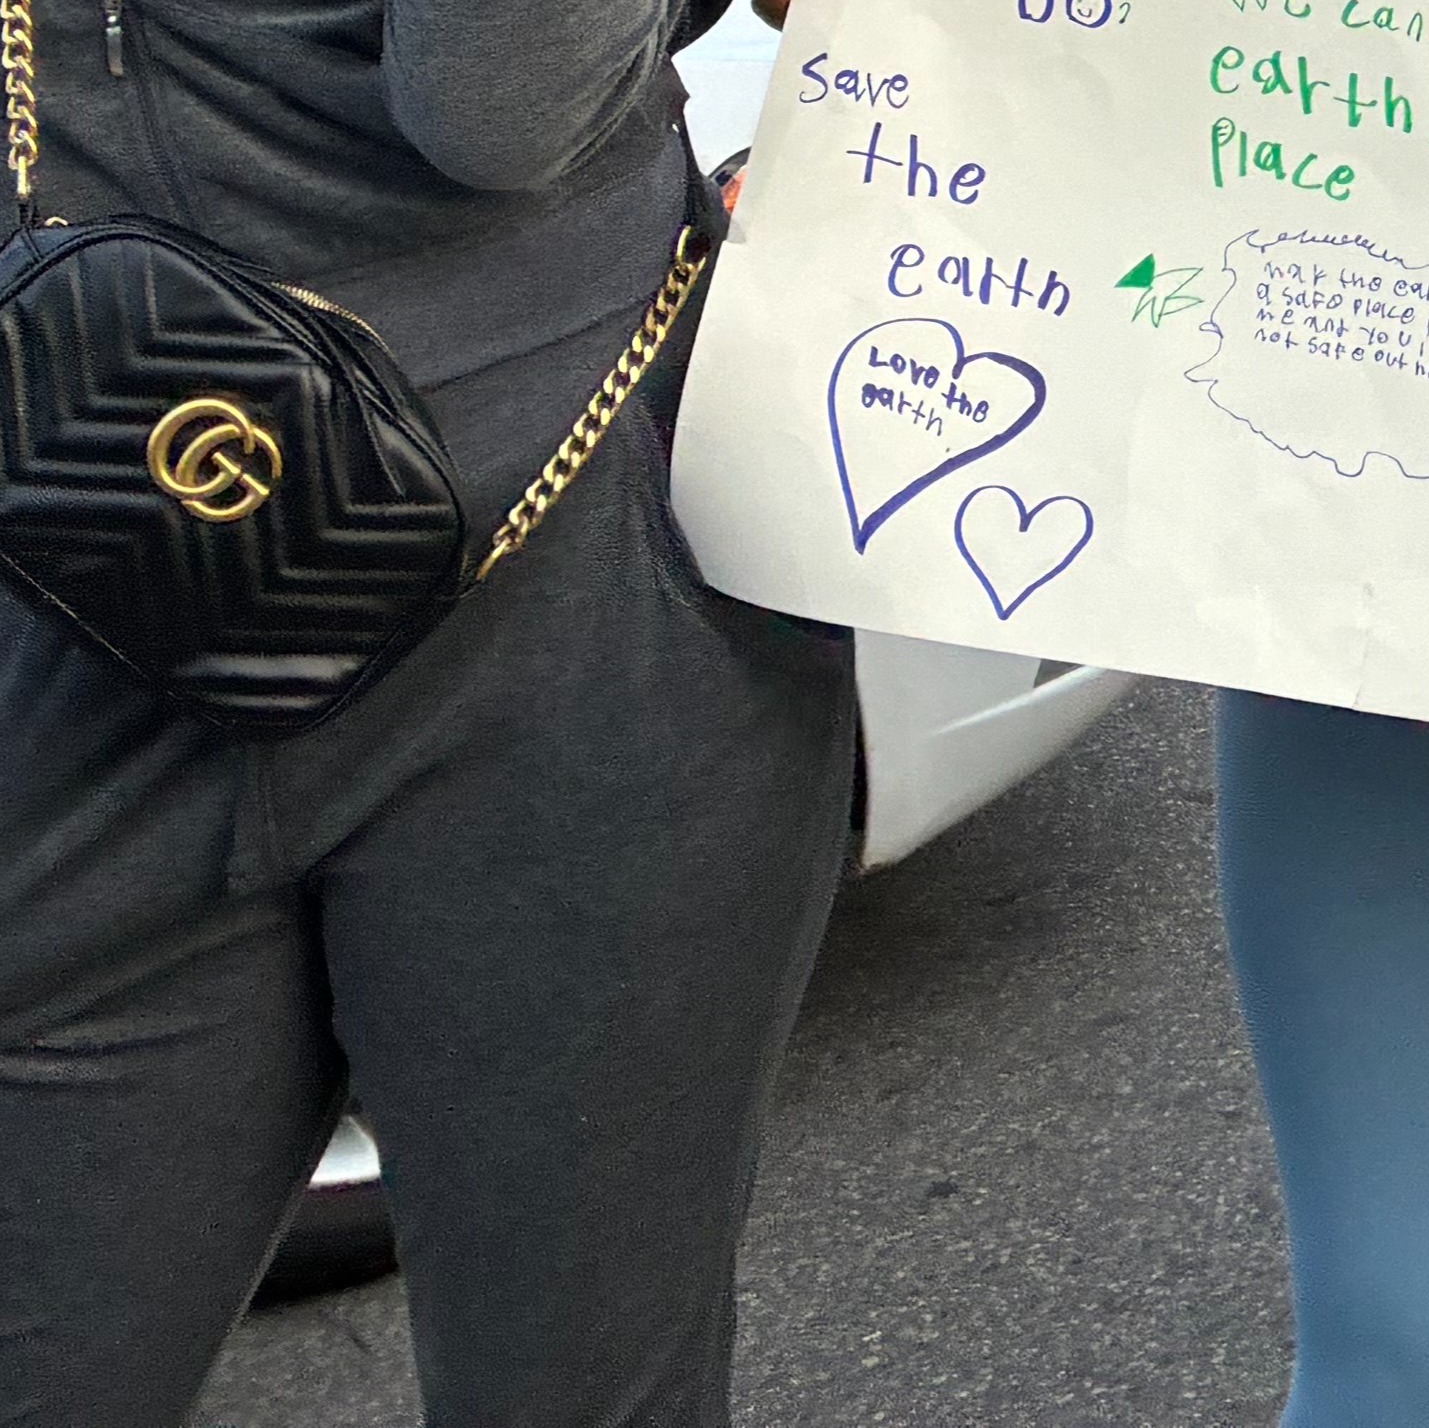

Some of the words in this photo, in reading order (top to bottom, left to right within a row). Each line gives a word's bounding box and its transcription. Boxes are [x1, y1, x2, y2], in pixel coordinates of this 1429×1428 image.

[1209, 44, 1414, 134] earth
[845, 120, 987, 206] the
[886, 242, 1071, 317] earth
[1256, 282, 1272, 306] a
[1338, 267, 1383, 293] the
[1254, 327, 1299, 350] not
[1374, 348, 1409, 370] out
[860, 382, 944, 437] earth
[940, 380, 990, 423] the
